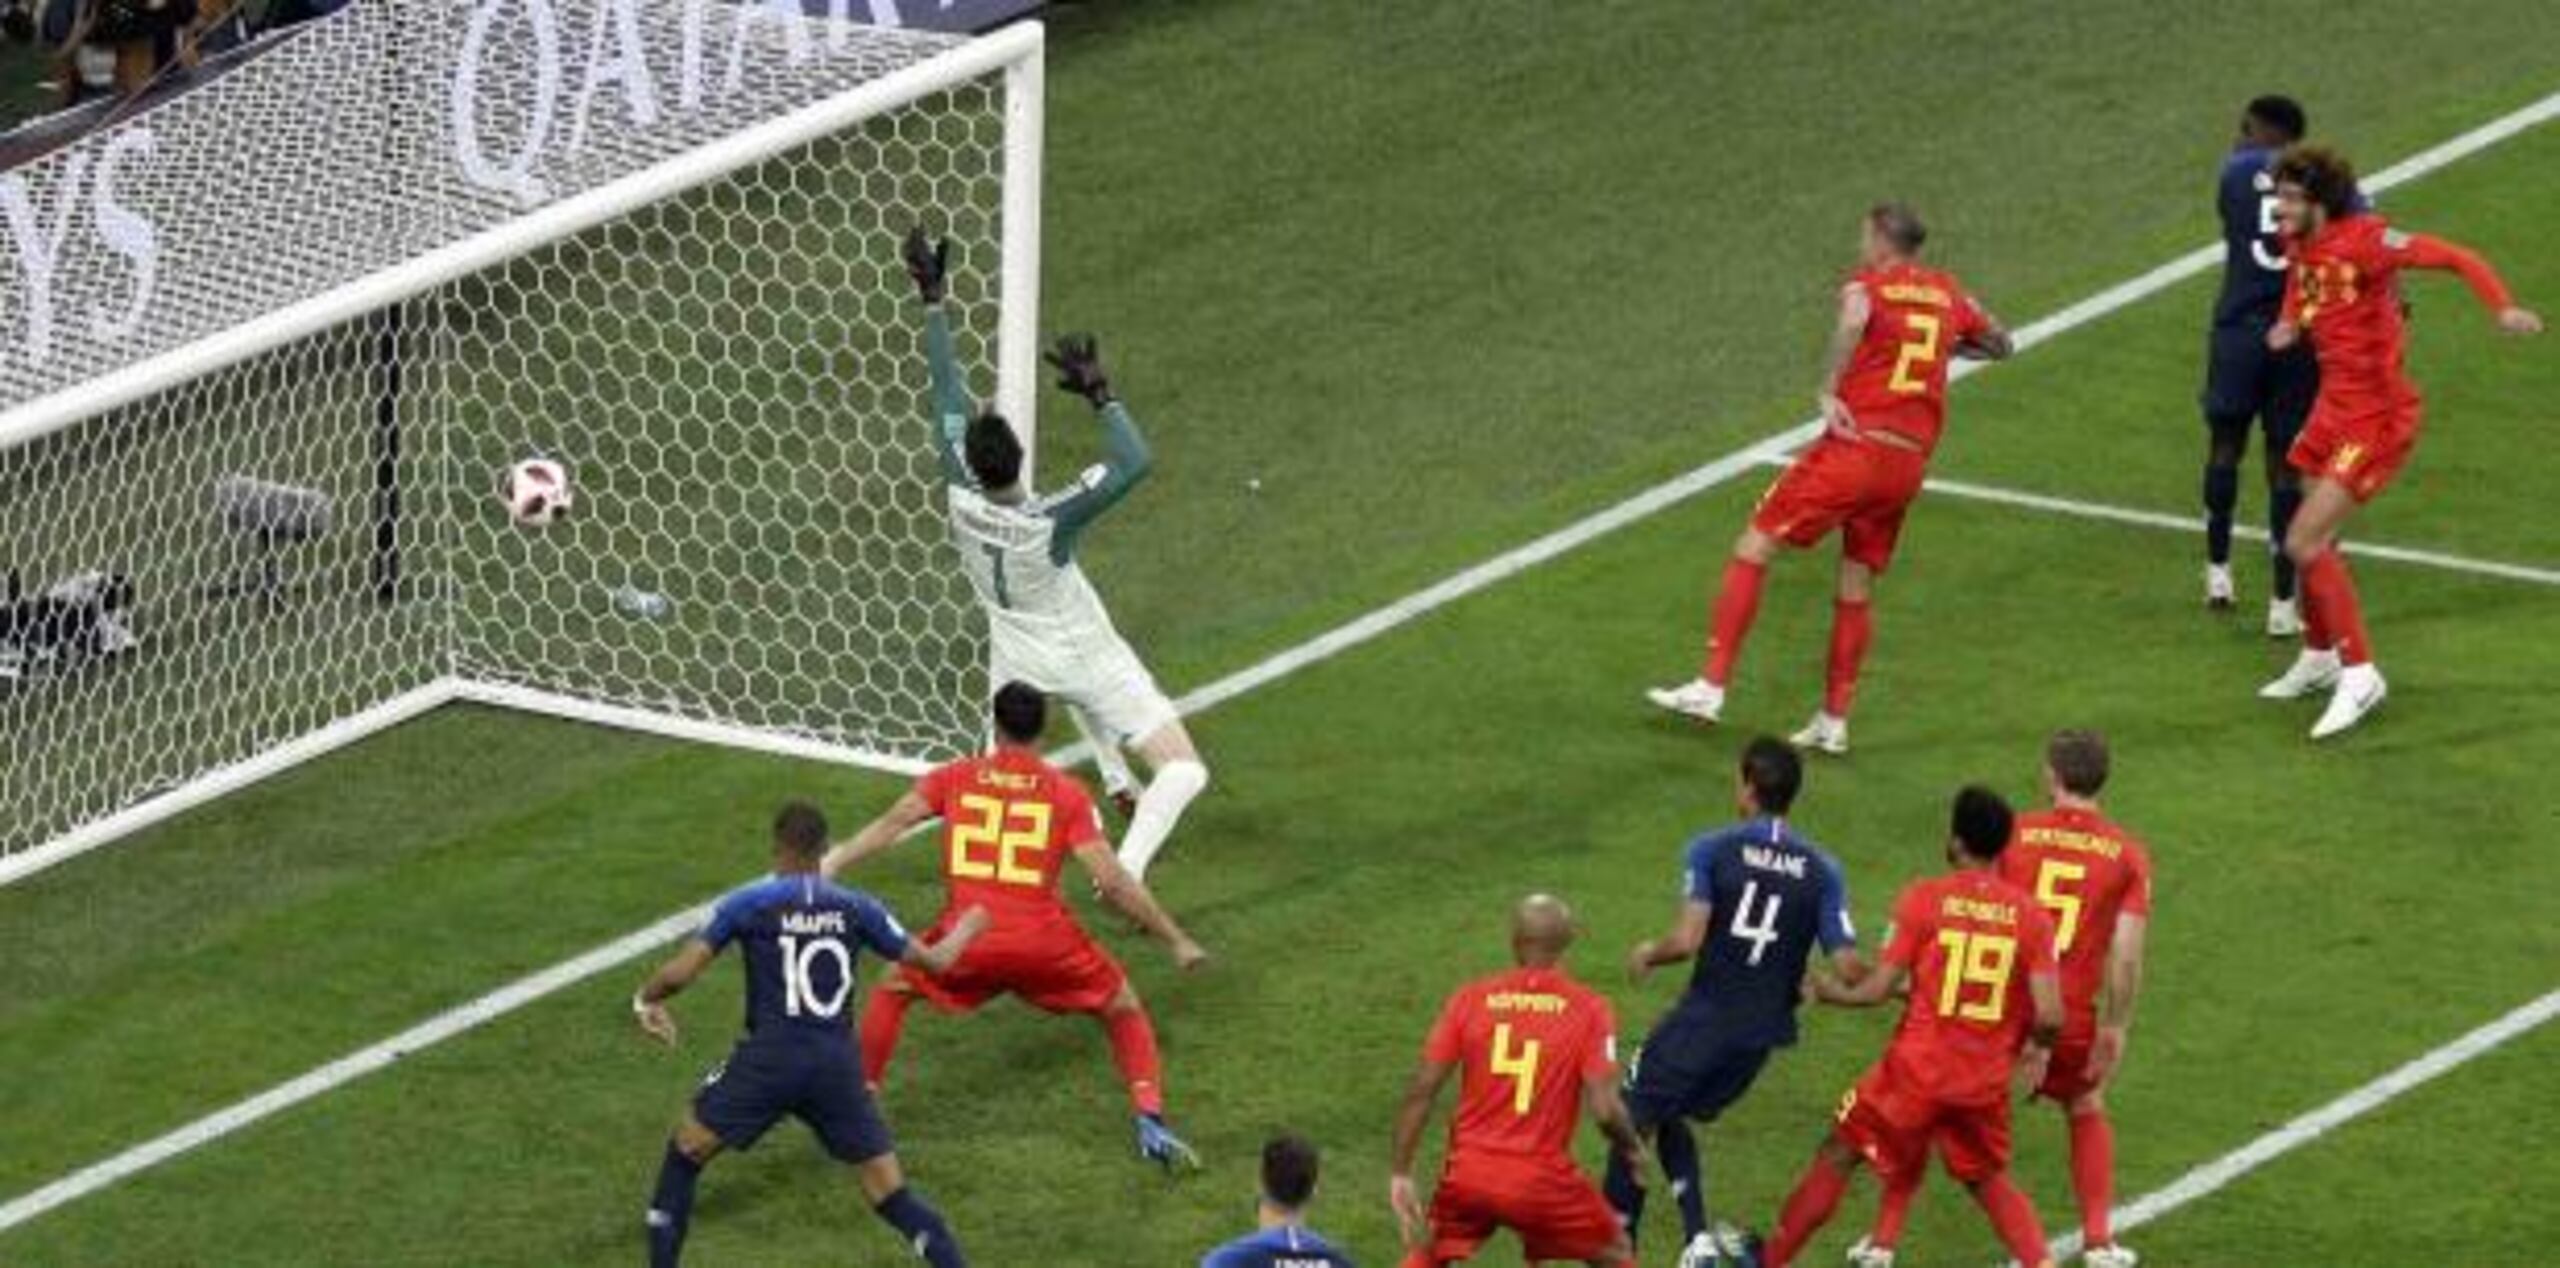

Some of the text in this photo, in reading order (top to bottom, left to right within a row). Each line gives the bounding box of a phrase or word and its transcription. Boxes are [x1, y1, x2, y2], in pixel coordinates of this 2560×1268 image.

[2252, 195, 2290, 270] 5
[1889, 314, 1939, 391] 2
[981, 541, 1011, 609] 7
[951, 794, 1052, 885] 22
[1730, 881, 1781, 965] 4
[2036, 858, 2086, 956] 5
[778, 935, 853, 1018] 10
[1938, 929, 2017, 1021] 19
[1490, 1023, 1540, 1115] 4
